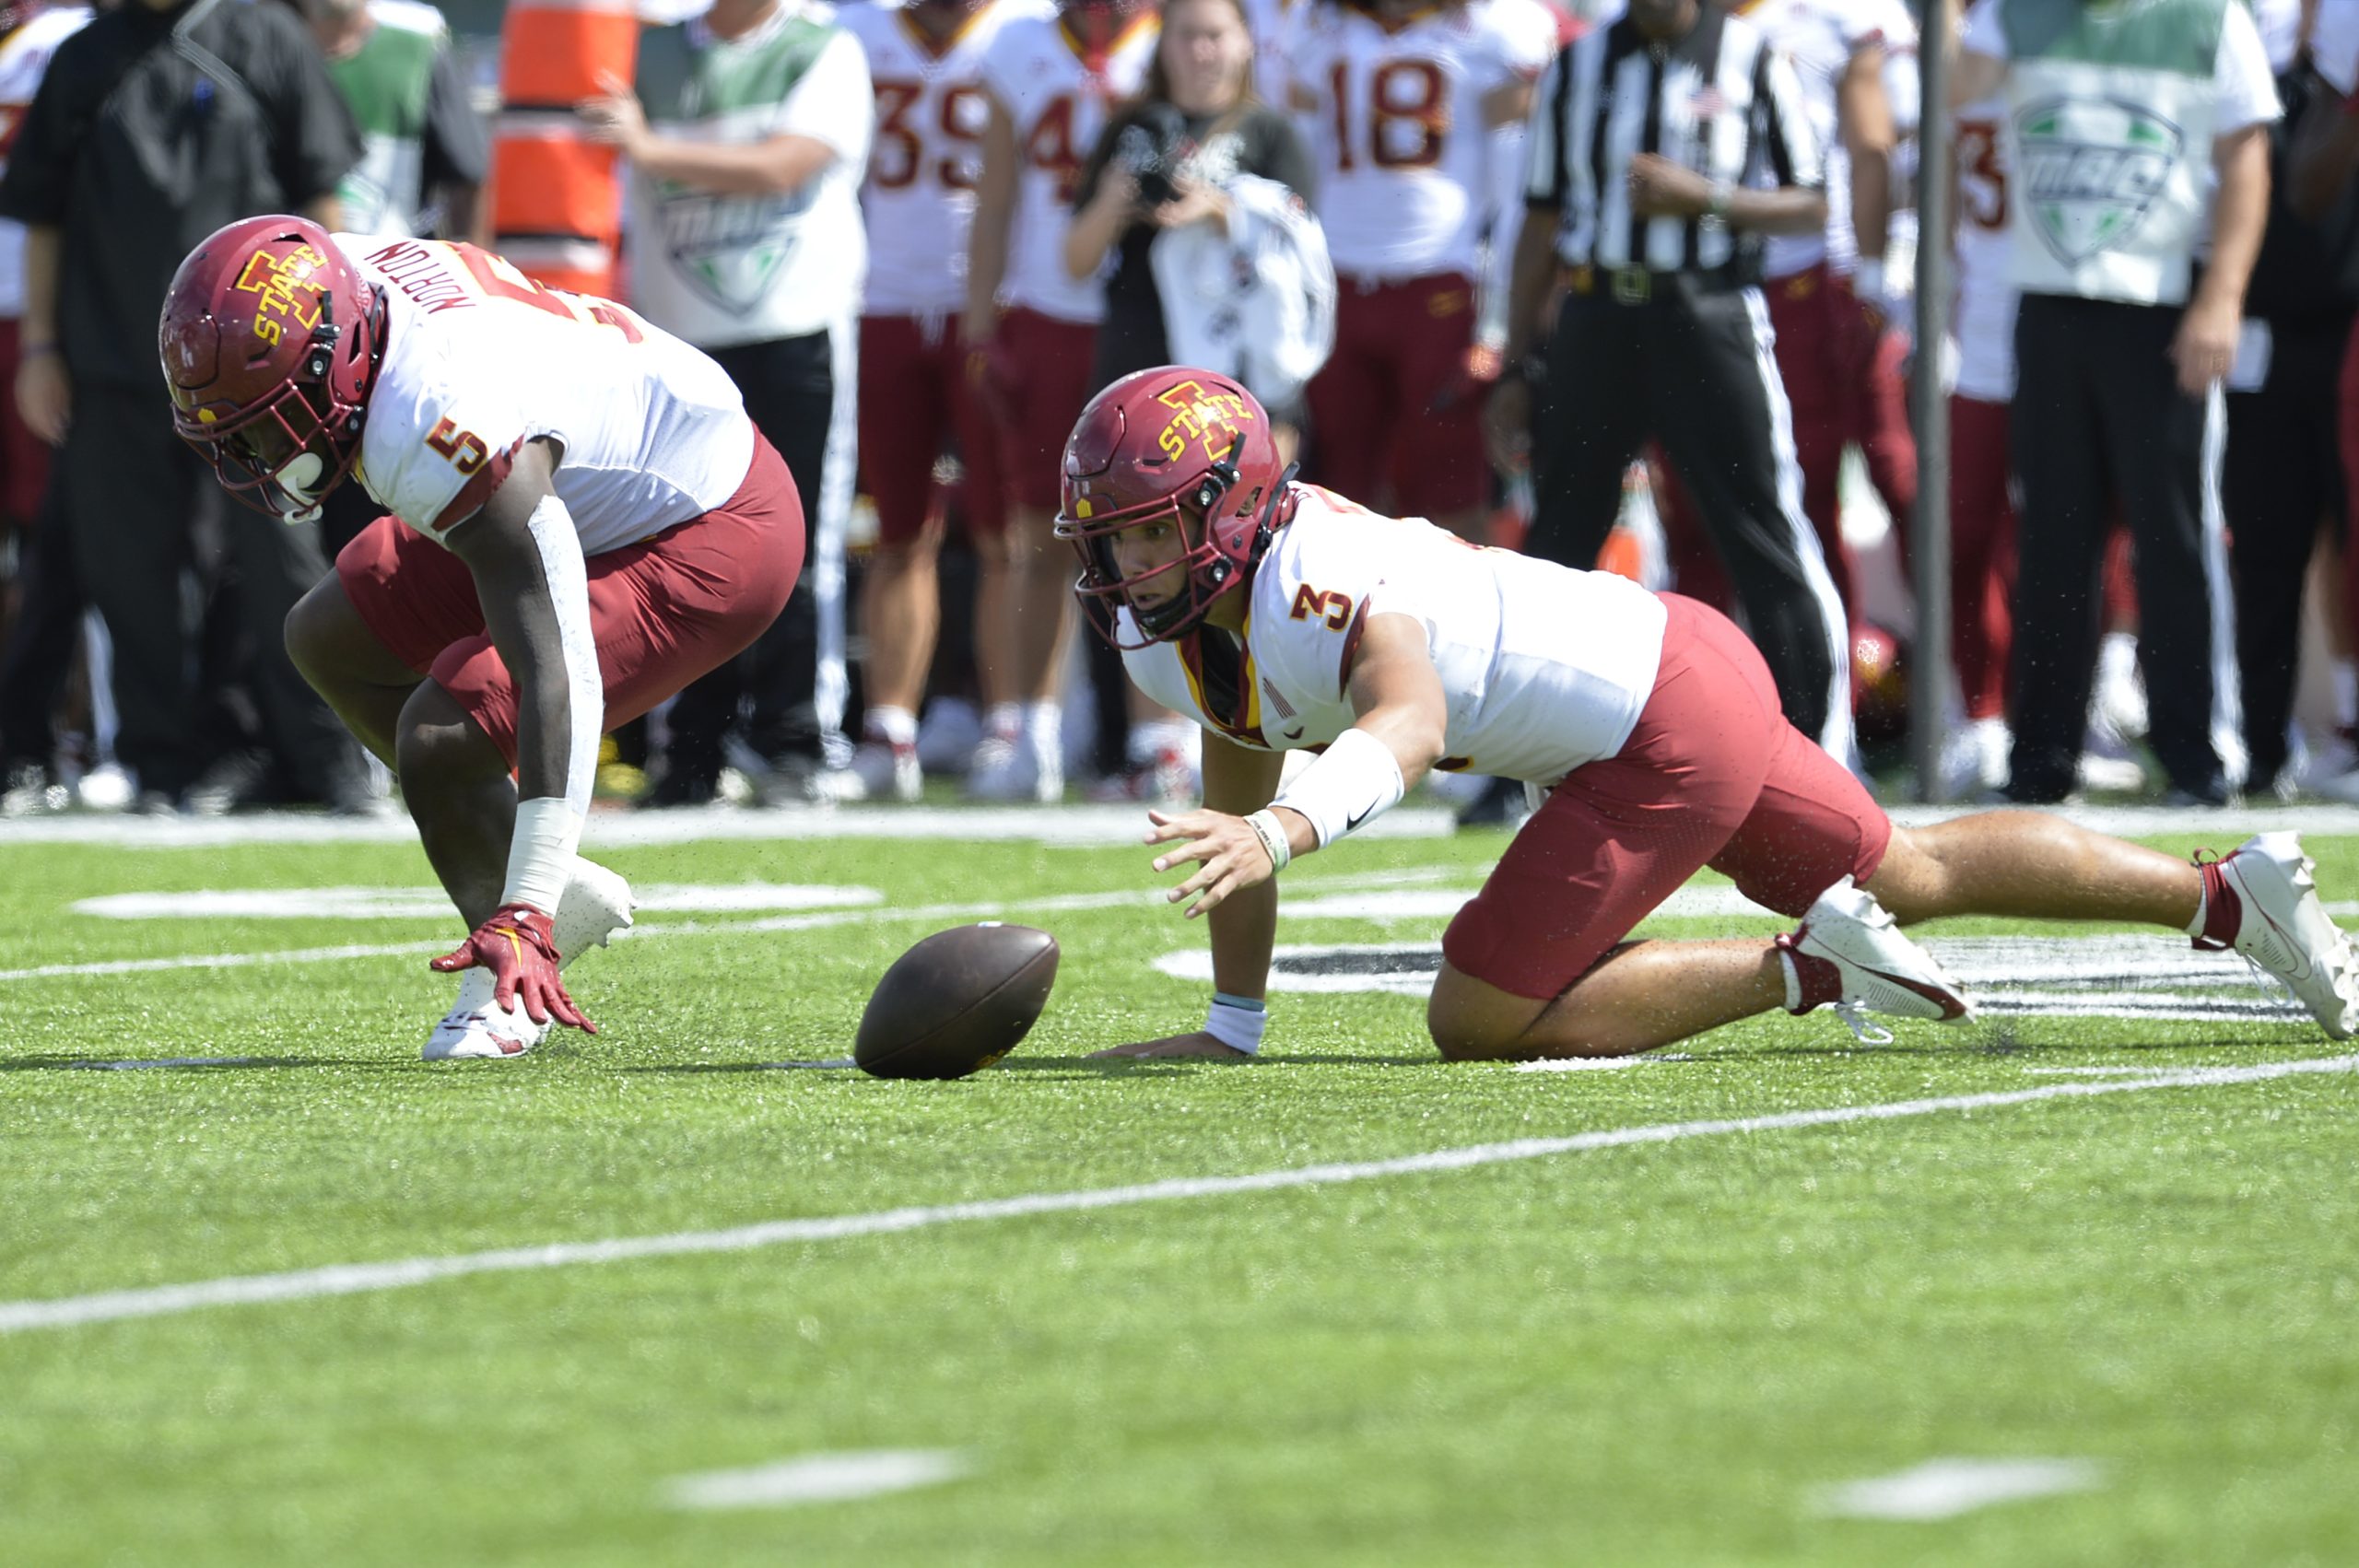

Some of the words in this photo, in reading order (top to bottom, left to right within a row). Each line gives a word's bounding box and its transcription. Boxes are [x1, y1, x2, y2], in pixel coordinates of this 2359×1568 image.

[1332, 57, 1444, 173] 18
[253, 243, 329, 347] STATE
[363, 240, 476, 315] NORTON
[424, 415, 488, 475] 5
[1158, 394, 1254, 462] STATE
[1290, 582, 1353, 633] 3
